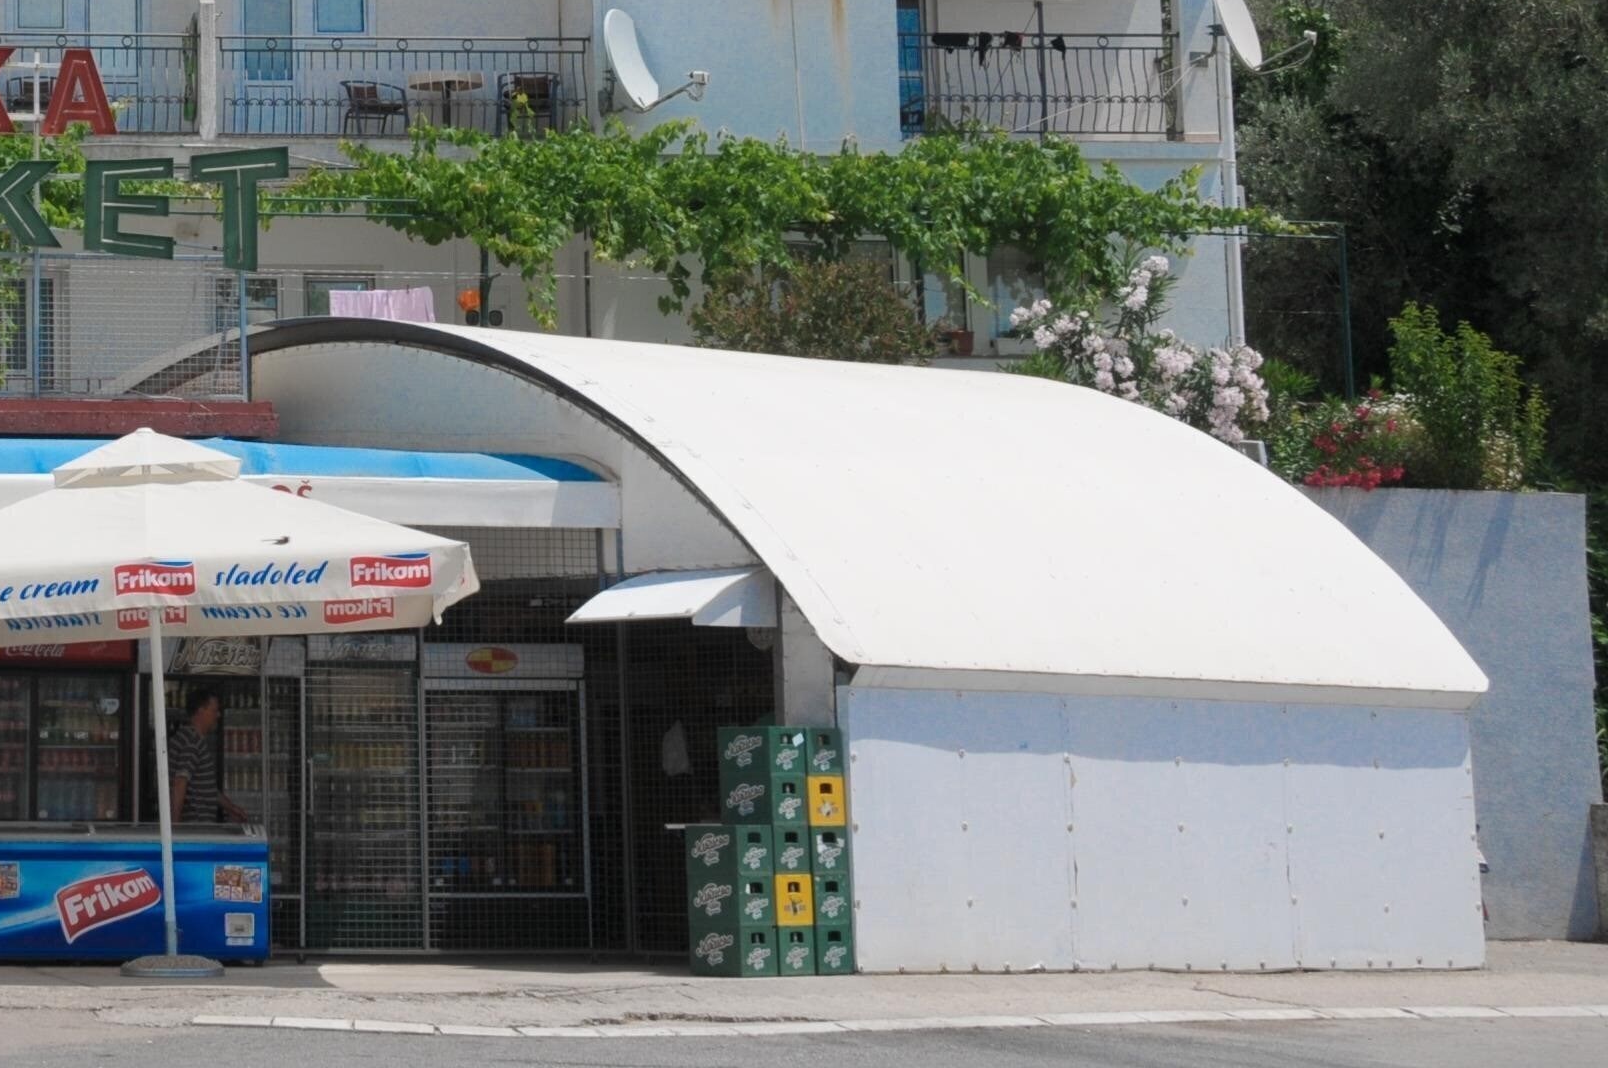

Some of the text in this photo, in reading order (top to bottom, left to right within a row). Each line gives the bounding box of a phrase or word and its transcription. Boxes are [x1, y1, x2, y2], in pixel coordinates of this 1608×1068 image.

[116, 568, 193, 590] Frikom
[214, 561, 328, 586] sladoled
[353, 562, 430, 582] Frikom
[19, 579, 99, 600] cream
[64, 872, 154, 925] Frikom
